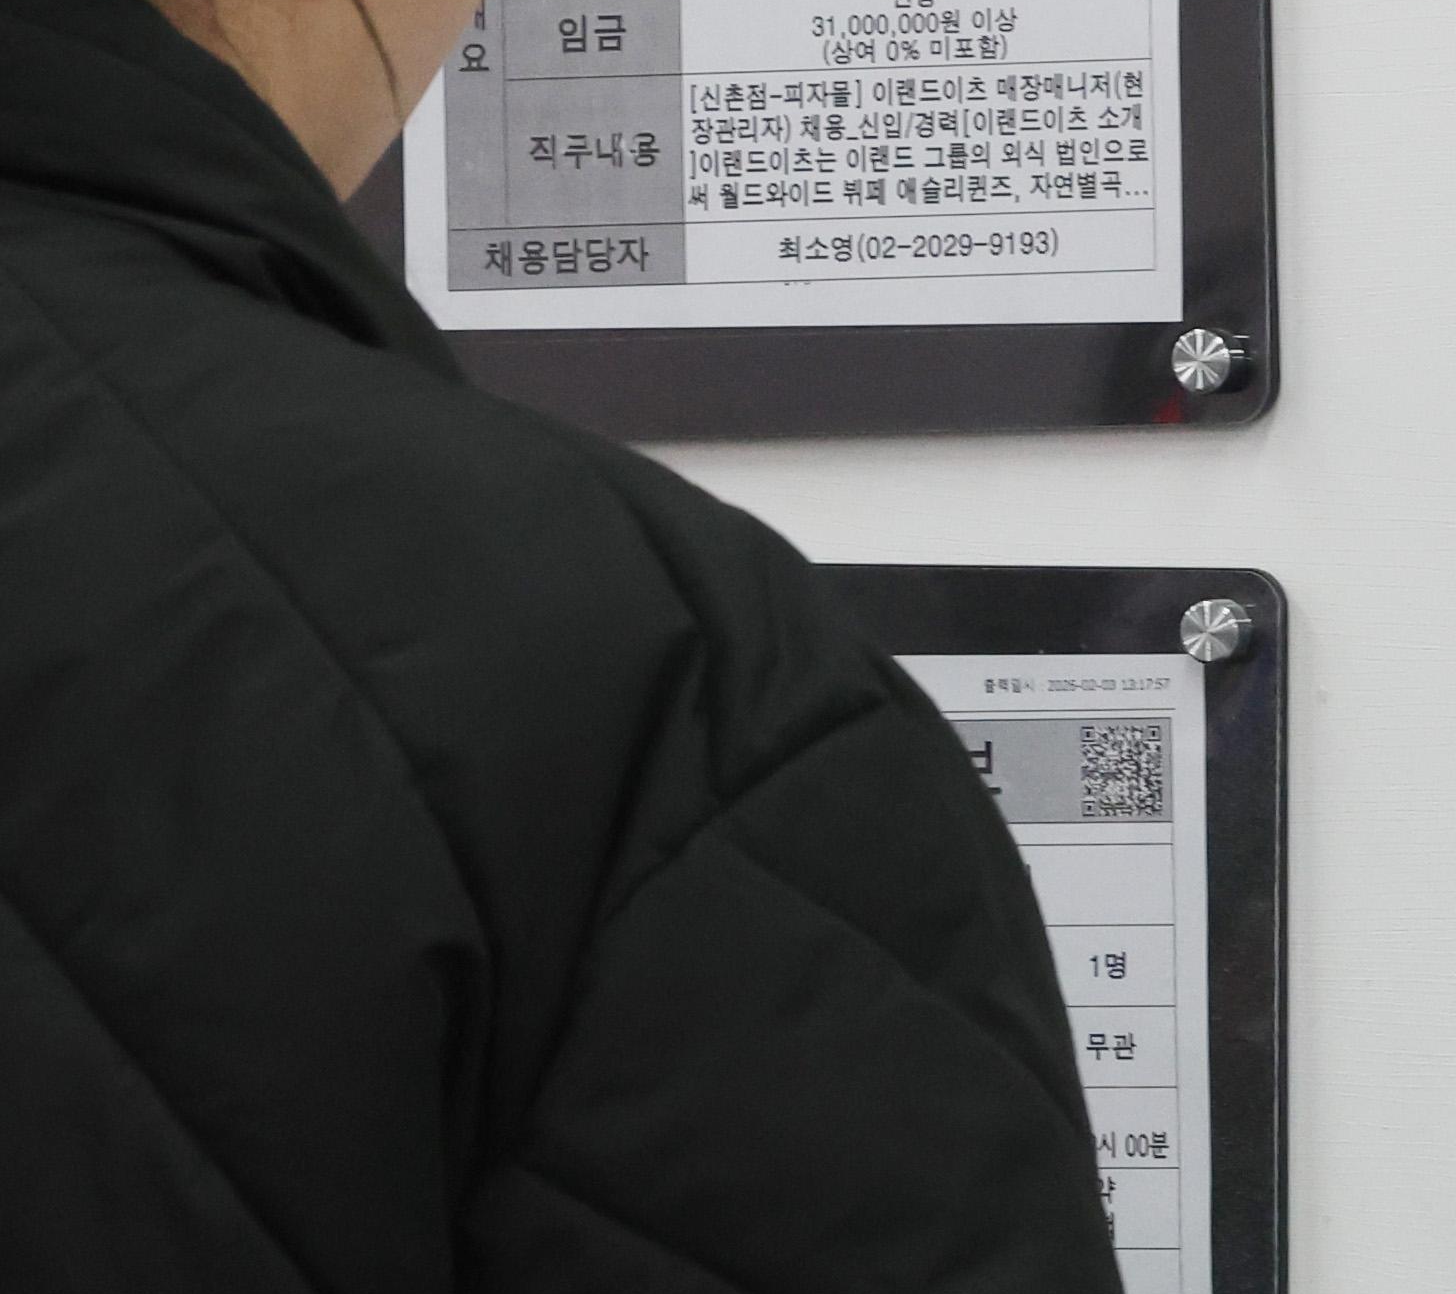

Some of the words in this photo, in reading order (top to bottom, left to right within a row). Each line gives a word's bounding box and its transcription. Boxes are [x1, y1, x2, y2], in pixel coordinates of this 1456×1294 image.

[484, 236, 650, 277] 채용담당자
[778, 227, 1059, 264] 최소영(02-2029-9193)
[1089, 951, 1127, 980] 1명
[1125, 1131, 1170, 1160] 00분
